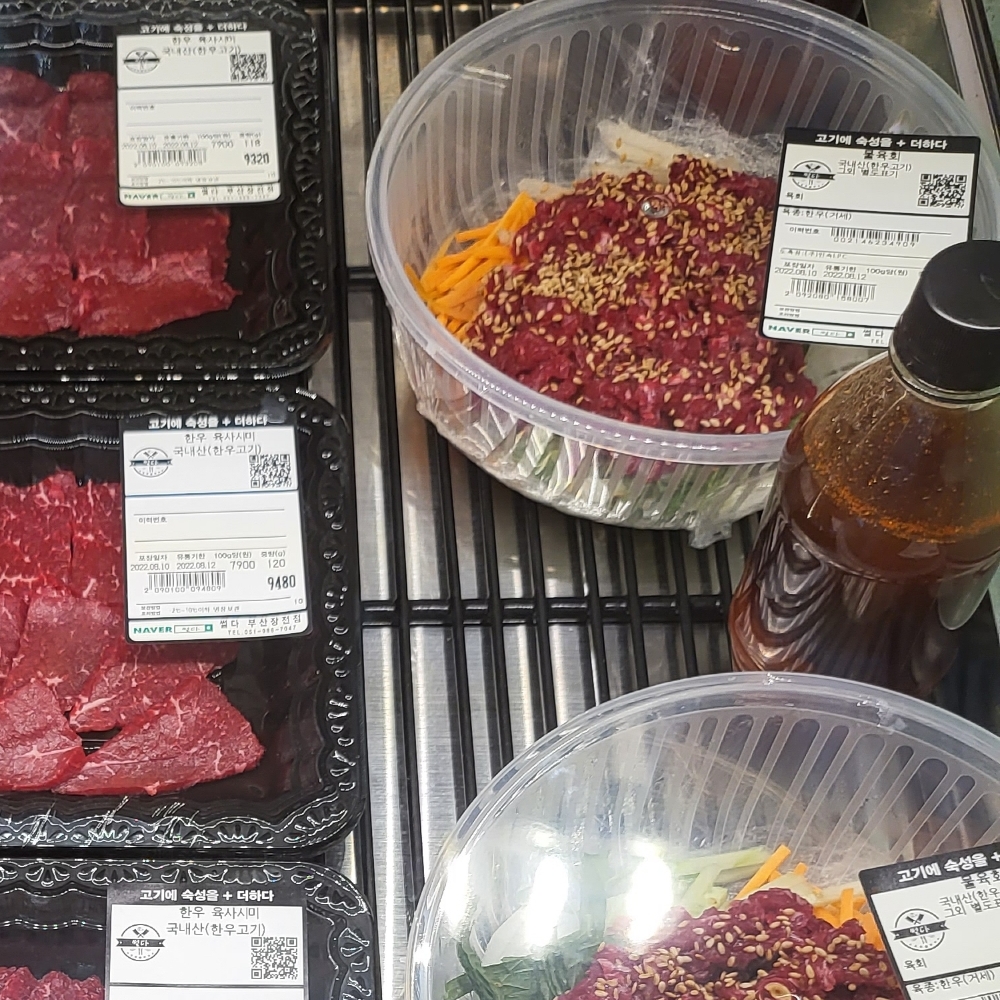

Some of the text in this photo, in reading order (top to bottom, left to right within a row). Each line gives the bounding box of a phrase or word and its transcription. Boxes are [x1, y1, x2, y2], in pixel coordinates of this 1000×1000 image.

[815, 134, 851, 145] 고기에
[856, 136, 892, 147] 숙성을
[910, 140, 948, 150] 더하다
[244, 153, 269, 165] 9320
[837, 160, 912, 171] 국내산(한우고기)
[769, 325, 810, 334] NAVER
[148, 417, 182, 429] 고기에
[186, 416, 218, 428] 숙성을
[235, 415, 267, 426] 더하다
[185, 432, 255, 443] 한우 육사시미
[173, 444, 261, 456] 국내산(한우고기)
[131, 559, 285, 571] 2022.08.10 2022.08.12 7900 120
[267, 575, 295, 590] 9480
[249, 615, 301, 627] 부산장전점
[897, 853, 988, 883] 고기에 숙성을
[140, 890, 177, 901] 고기에
[181, 890, 219, 901] 숙성을
[237, 890, 274, 902] 더하다
[940, 887, 1000, 907] 국내산(한우
[971, 896, 1000, 912] 별도
[180, 907, 259, 919] 한우 육사시미
[167, 923, 266, 936] 국내산(한우고기)
[904, 958, 927, 969] 육회
[912, 970, 995, 994] 육종:한우(거세)
